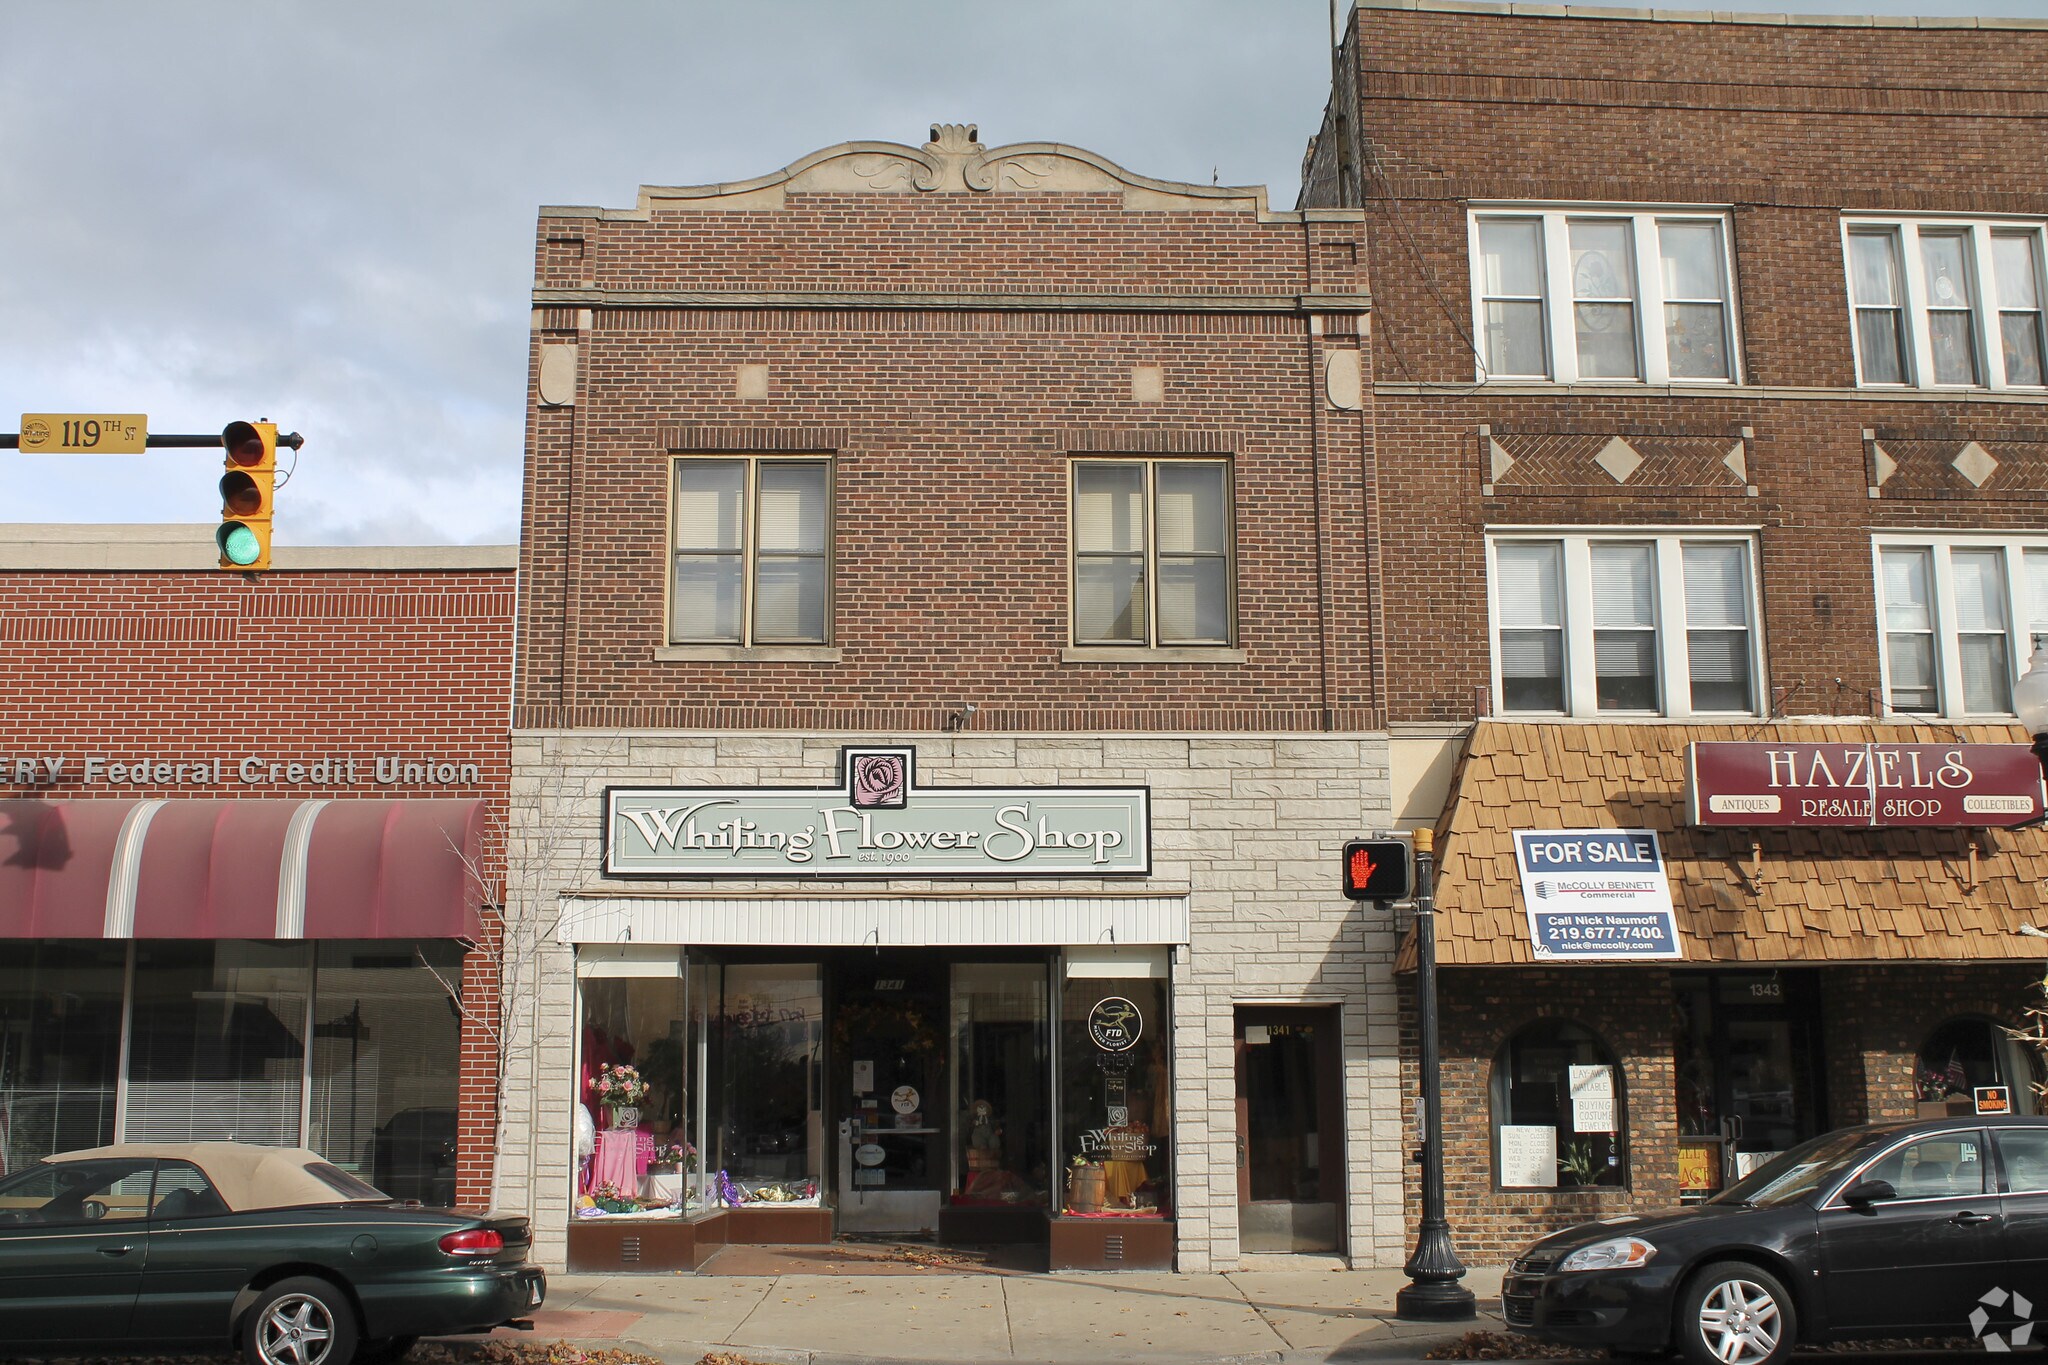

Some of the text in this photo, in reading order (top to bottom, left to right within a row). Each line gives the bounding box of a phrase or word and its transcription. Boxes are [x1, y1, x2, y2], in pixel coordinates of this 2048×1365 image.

[84, 757, 221, 784] Federal
[239, 756, 356, 784] Credit
[376, 756, 479, 784] Union
[1766, 750, 1973, 789] HAZELS
[1721, 799, 1770, 812] ANTIQUES
[1801, 799, 1942, 817] RESALE SHOP
[1967, 798, 2030, 811] COLLECTIBLES
[617, 799, 1122, 865] Whiting Flower Shop
[858, 851, 910, 865] est. 1900
[1529, 842, 1653, 864] FOR SALE
[1608, 881, 1655, 890] BENNETT
[1548, 915, 1658, 926] Call Nick Naumoff
[1549, 927, 1662, 940] 219.677.7400
[1561, 941, 1654, 951] nick@mccolly.com
[1750, 984, 1780, 996] 1343
[1106, 1029, 1122, 1037] FTD
[1268, 1025, 1290, 1036] 1341
[1573, 1069, 1613, 1079] LAY-AWAYS
[1572, 1082, 1608, 1092] AVAILABLE
[1986, 1090, 1997, 1100] NO
[1579, 1101, 1611, 1111] BUYING
[1979, 1100, 2007, 1110] SMOKING
[1579, 1111, 1614, 1121] COSTUME
[1579, 1121, 1612, 1131] JEWELRY
[1083, 1128, 1145, 1145] Whiting
[1079, 1135, 1157, 1156] Flower Shop
